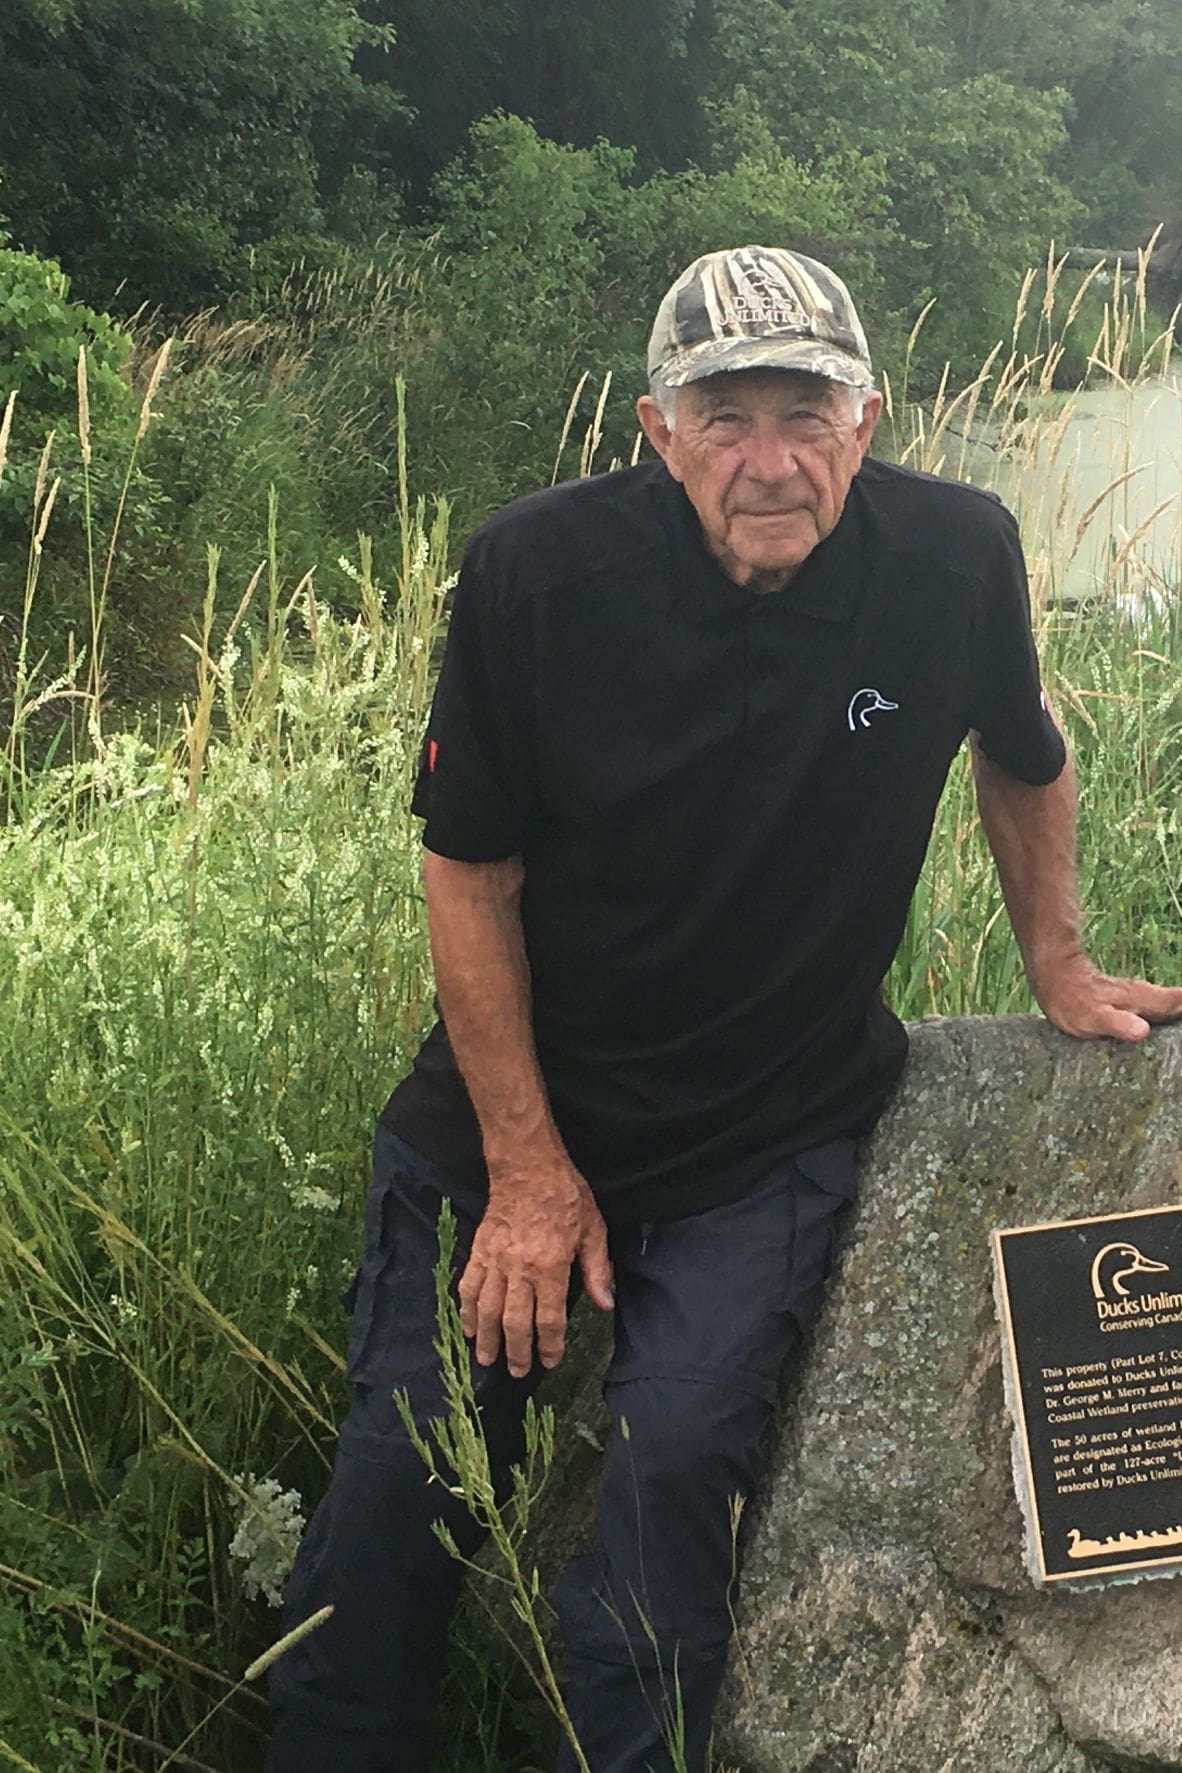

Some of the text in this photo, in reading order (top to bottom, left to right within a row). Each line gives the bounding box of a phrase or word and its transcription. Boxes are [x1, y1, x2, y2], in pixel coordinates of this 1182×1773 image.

[732, 296, 793, 310] DUCKS
[718, 309, 811, 326] UNLIMITED
[1097, 1297, 1140, 1318] Ducks
[1100, 1317, 1154, 1332] Conserving
[1041, 1368, 1063, 1378] This
[1066, 1362, 1107, 1377] property
[1138, 1354, 1155, 1364] Lot
[1044, 1384, 1064, 1392] was
[1068, 1375, 1108, 1390] donated
[1112, 1375, 1122, 1383] to
[1125, 1370, 1156, 1381] Ducks
[1063, 1394, 1099, 1406] George
[1118, 1388, 1146, 1397] Merry
[1150, 1382, 1169, 1393] and
[1048, 1409, 1085, 1423] Coastal
[1087, 1403, 1129, 1417] Wetland
[1051, 1439, 1070, 1448] The
[1075, 1434, 1086, 1445] 50
[1091, 1432, 1118, 1442] acres
[1122, 1427, 1132, 1438] of
[1136, 1422, 1176, 1435] wetland
[1054, 1455, 1069, 1463] are
[1073, 1444, 1128, 1460] designated
[1131, 1444, 1142, 1452] as
[1056, 1468, 1076, 1480] part
[1083, 1464, 1093, 1474] of
[1100, 1462, 1116, 1472] the
[1124, 1456, 1166, 1468] 127-acre
[1058, 1479, 1099, 1494] restored
[1102, 1478, 1113, 1488] by
[1116, 1473, 1147, 1485] Ducks
